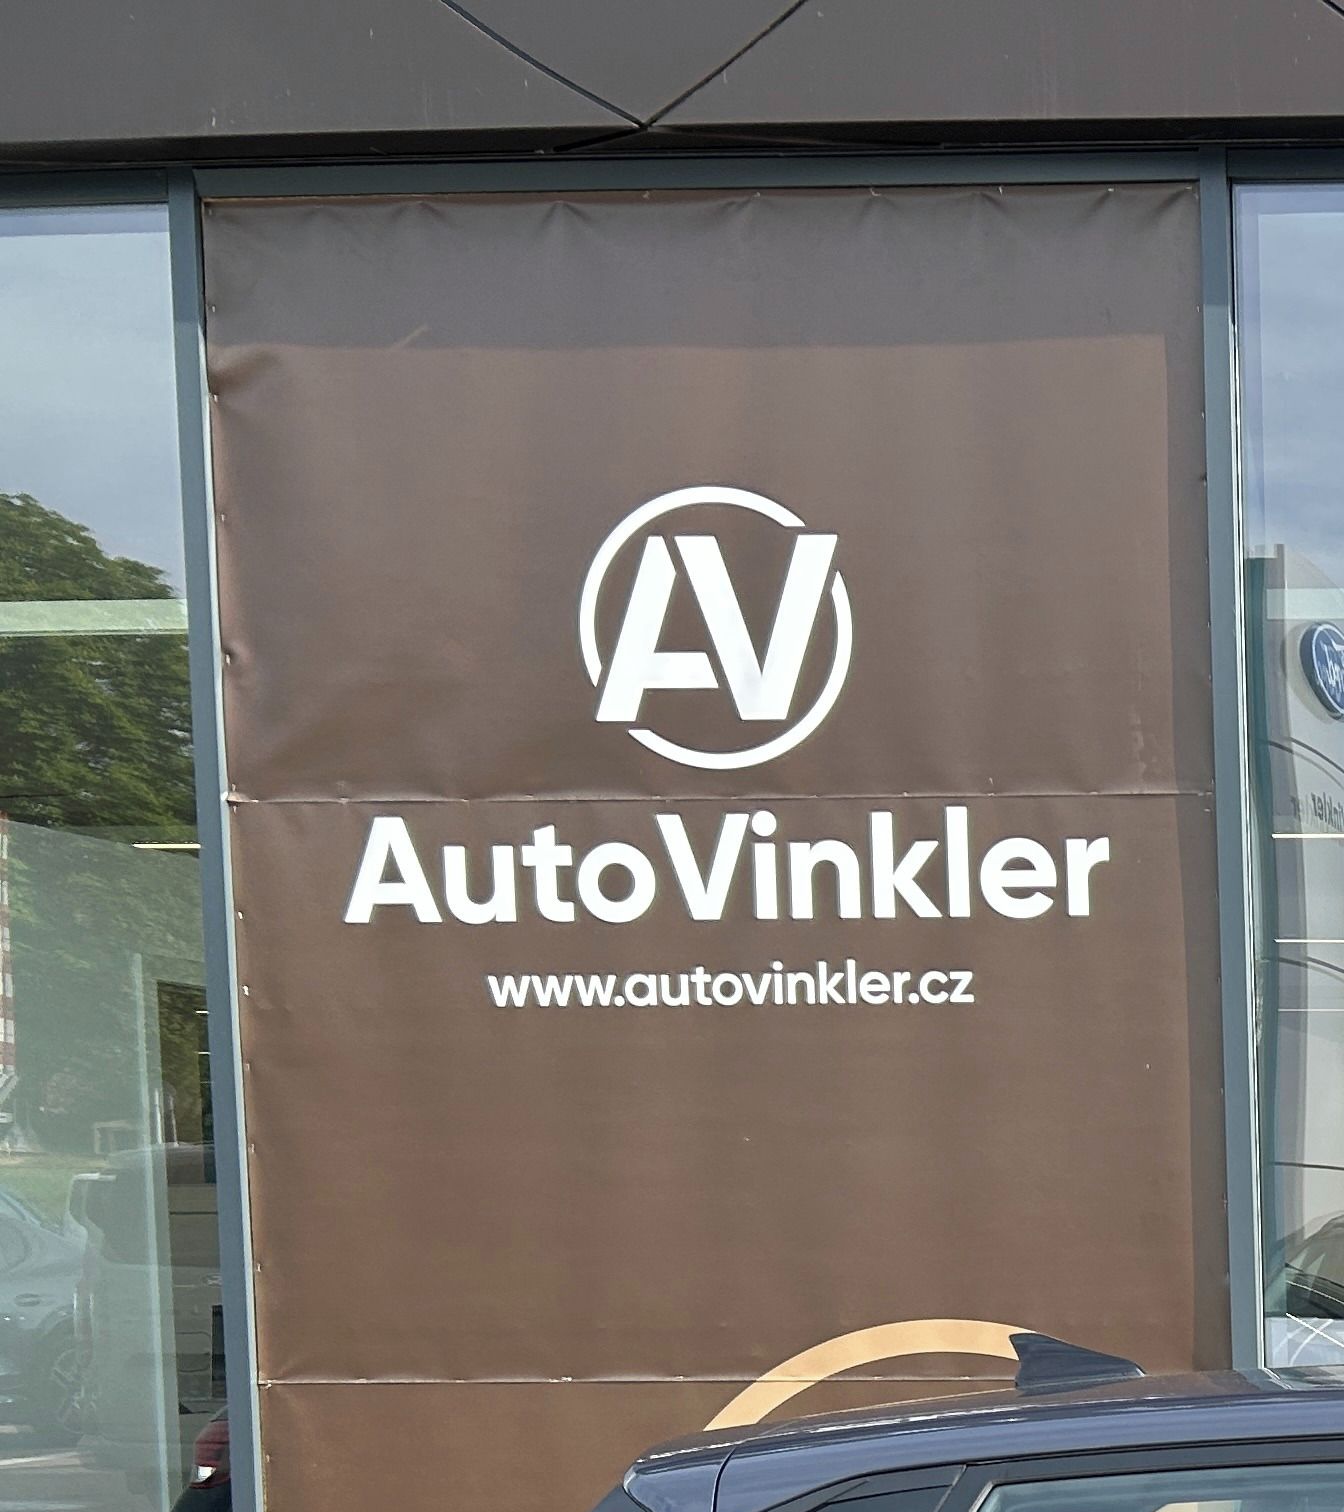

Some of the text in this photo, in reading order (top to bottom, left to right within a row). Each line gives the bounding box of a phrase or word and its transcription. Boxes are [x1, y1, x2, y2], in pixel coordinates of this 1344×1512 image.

[595, 533, 838, 722] AV
[344, 806, 1111, 925] AutoVinkler
[487, 959, 975, 1009] www.autovinkler.cz
